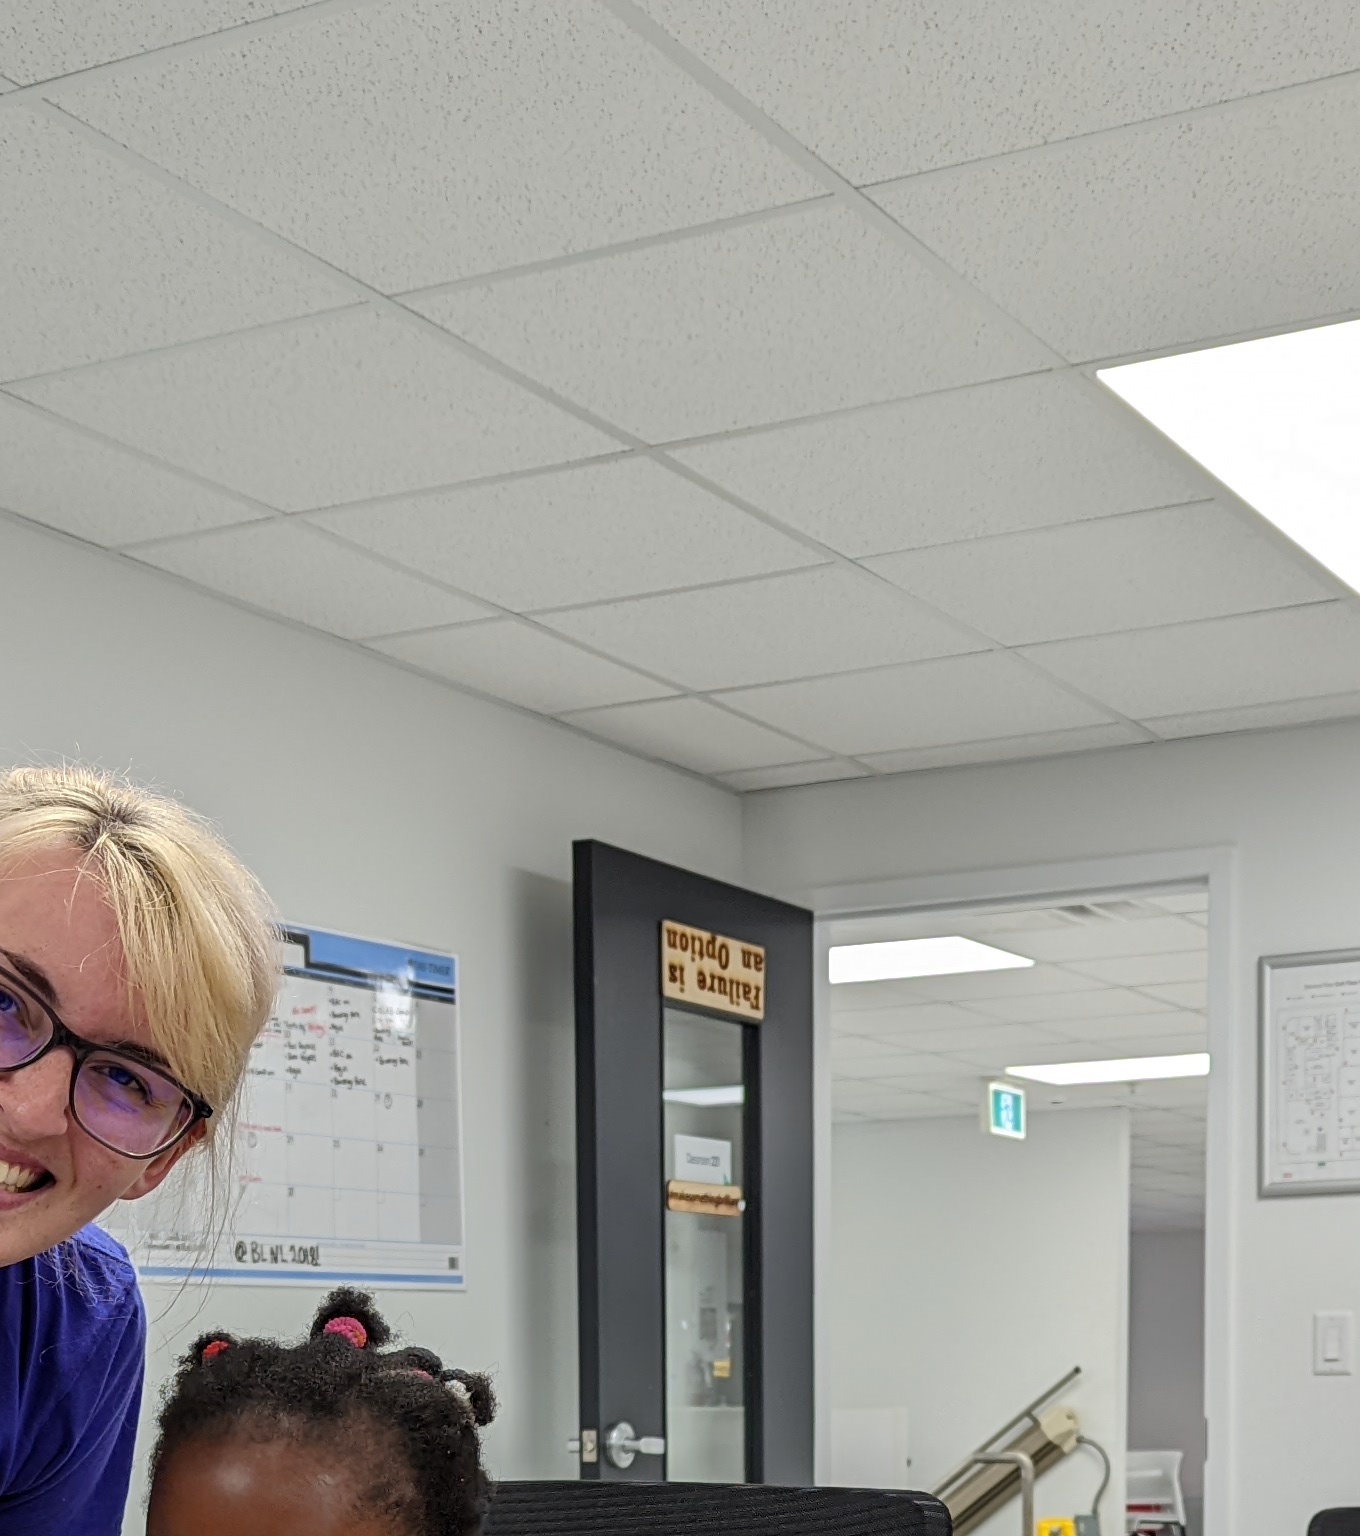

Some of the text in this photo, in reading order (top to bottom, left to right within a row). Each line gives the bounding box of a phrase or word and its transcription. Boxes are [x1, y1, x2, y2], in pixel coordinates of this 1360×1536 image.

[666, 928, 763, 973] an Option
[668, 963, 761, 1011] Failure is
